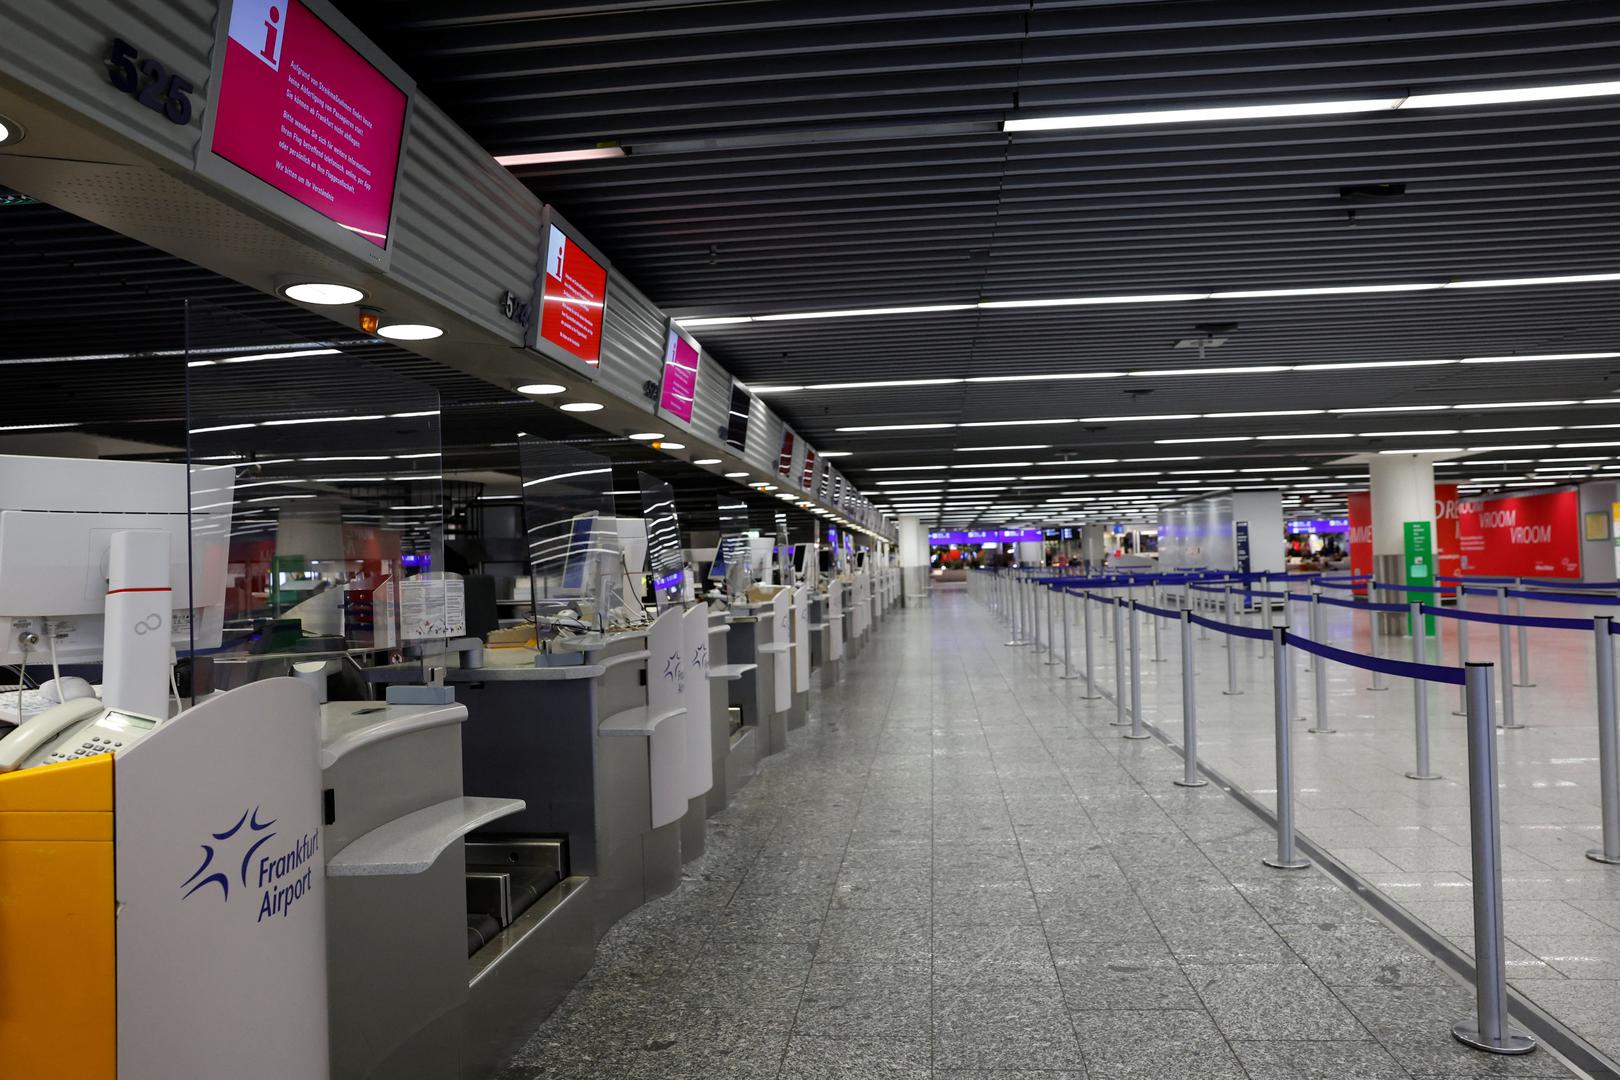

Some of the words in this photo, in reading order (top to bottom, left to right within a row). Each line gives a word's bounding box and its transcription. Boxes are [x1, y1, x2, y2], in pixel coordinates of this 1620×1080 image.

[109, 38, 194, 125] 525
[288, 75, 300, 88] keine
[301, 84, 324, 108] Abfertigung
[291, 61, 310, 80] Aufgrund
[352, 108, 362, 120] findet
[363, 118, 373, 128] heute
[316, 110, 334, 128] Frankfurt
[334, 126, 344, 136] nicht
[279, 141, 289, 150] oder
[289, 148, 310, 165] persönlich
[317, 164, 325, 174] Ihre
[281, 125, 292, 137] Ihren
[293, 133, 302, 146] Flug
[303, 140, 324, 158] betreffend
[283, 110, 294, 123] Bitte
[295, 120, 311, 134] wenden
[318, 136, 327, 145] sich
[334, 147, 347, 160] weitere
[348, 156, 371, 176] Informationen
[275, 160, 284, 171] Wir
[285, 167, 297, 179] bitten
[298, 176, 305, 184] um
[1479, 510, 1517, 528] VROOM
[1510, 525, 1552, 543] VROOM
[259, 827, 319, 888] Frankfurt
[257, 867, 312, 922] Airport
